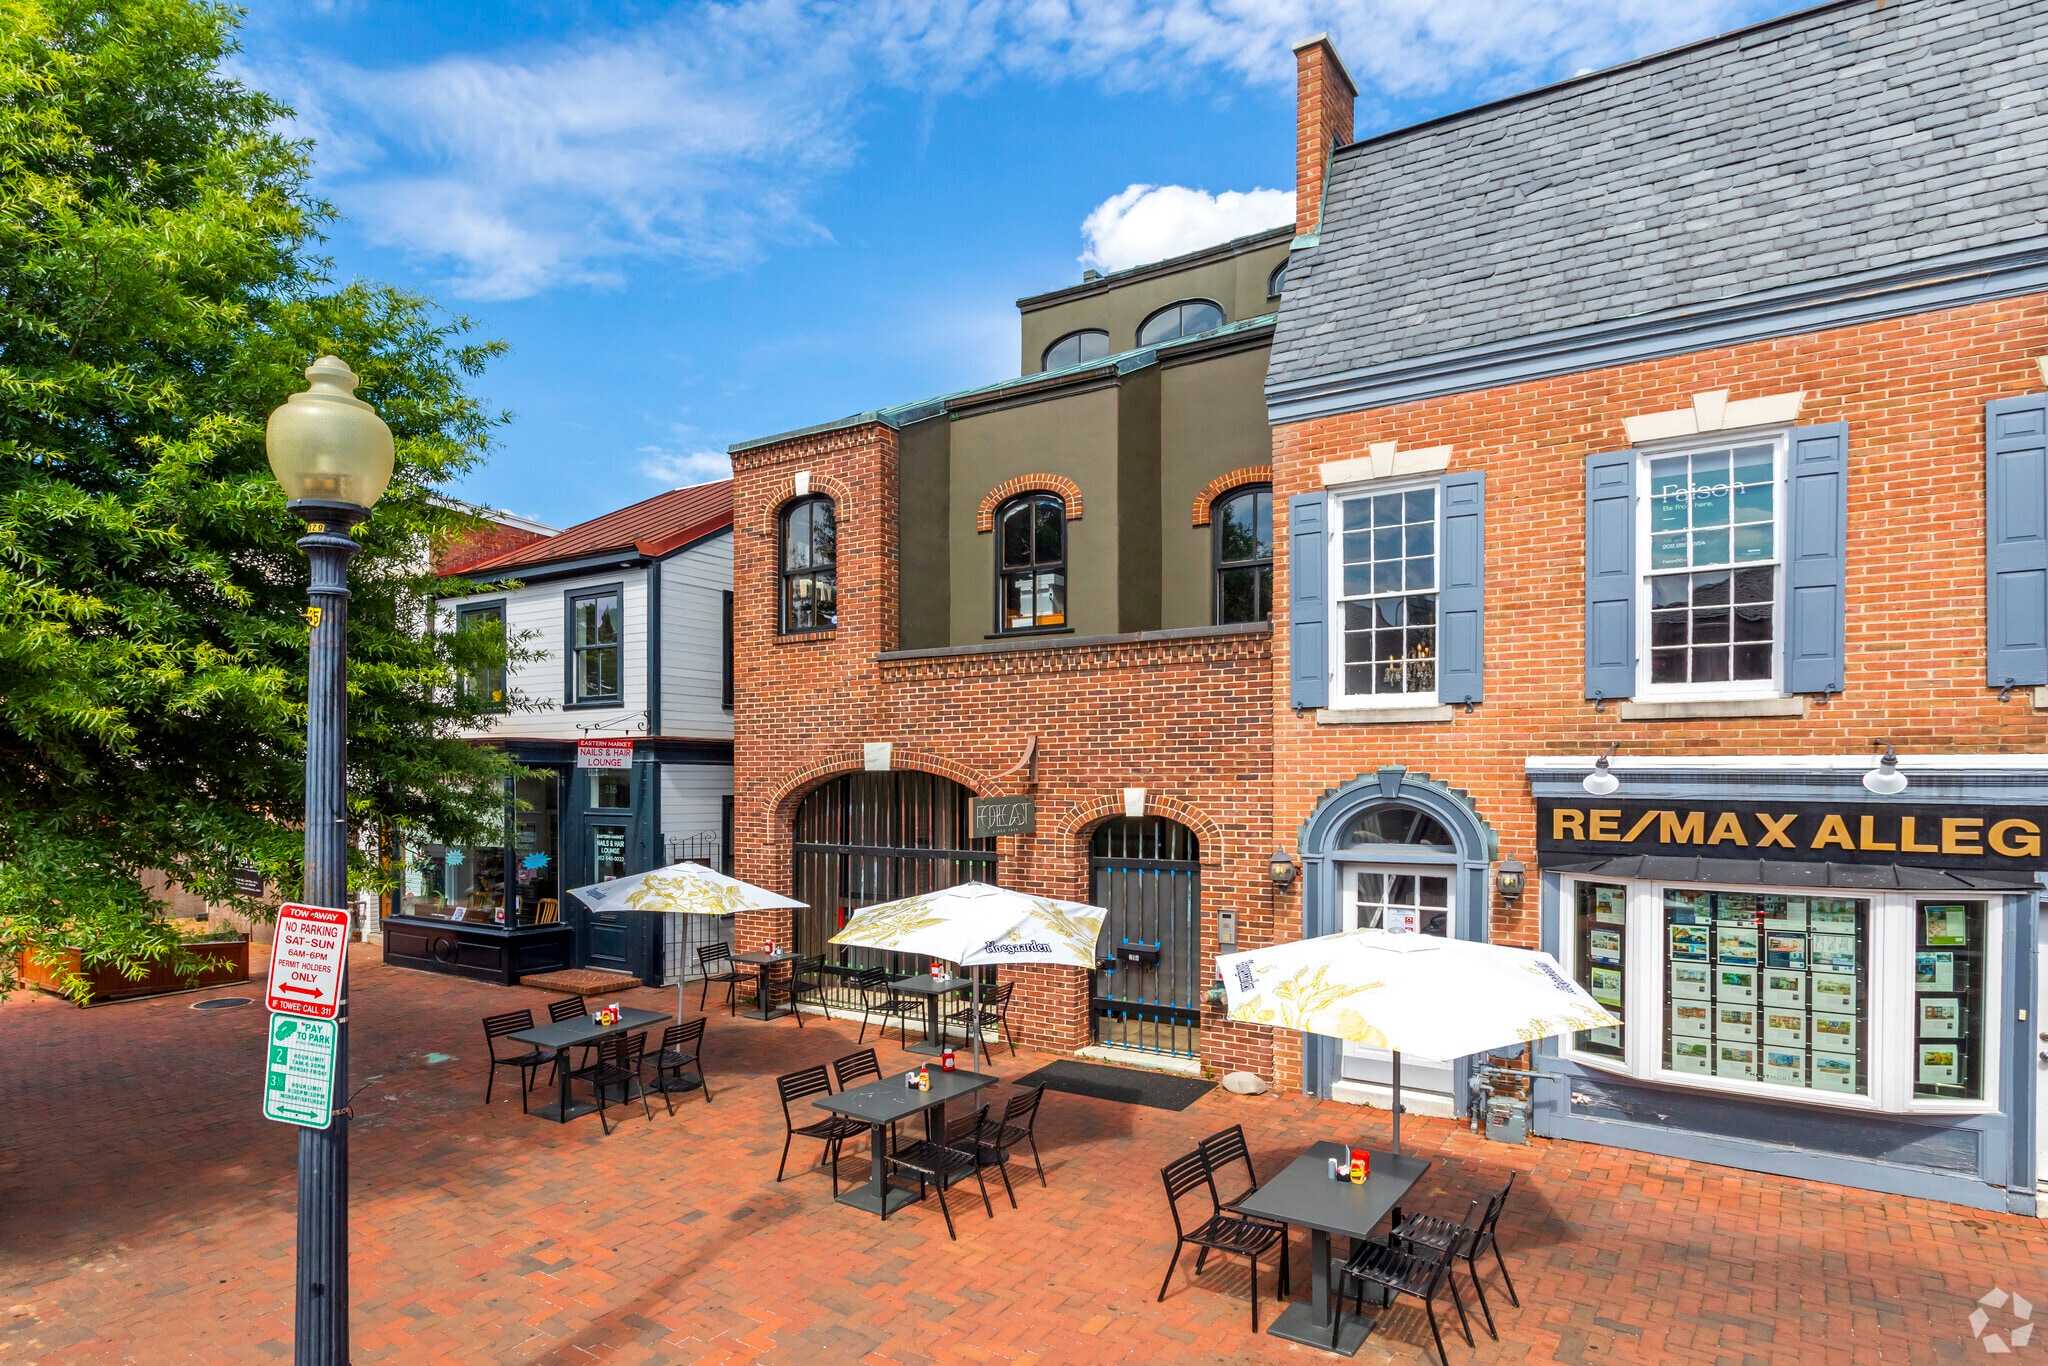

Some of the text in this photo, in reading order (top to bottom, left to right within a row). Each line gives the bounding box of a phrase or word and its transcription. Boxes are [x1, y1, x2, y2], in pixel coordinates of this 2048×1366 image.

[1662, 482, 1745, 503] Faison
[580, 748, 631, 756] NAILS & HAIR
[588, 758, 622, 766] LOUNGE
[605, 785, 618, 794] 216
[1552, 809, 2041, 857] RE/MAX ALLEG
[285, 921, 338, 938] NO PARKING
[285, 935, 335, 950] SAT-SUN
[985, 940, 1052, 954] Hoegaarden
[288, 949, 328, 960] 6AM-6PM
[278, 959, 331, 973] PERMIT HOLDERS
[291, 972, 318, 983] ONLY
[280, 1001, 302, 1010] TOWED
[303, 1005, 319, 1014] CALL
[305, 1024, 323, 1033] PAY
[297, 1032, 330, 1044] TO PARK
[276, 1048, 282, 1062] 2
